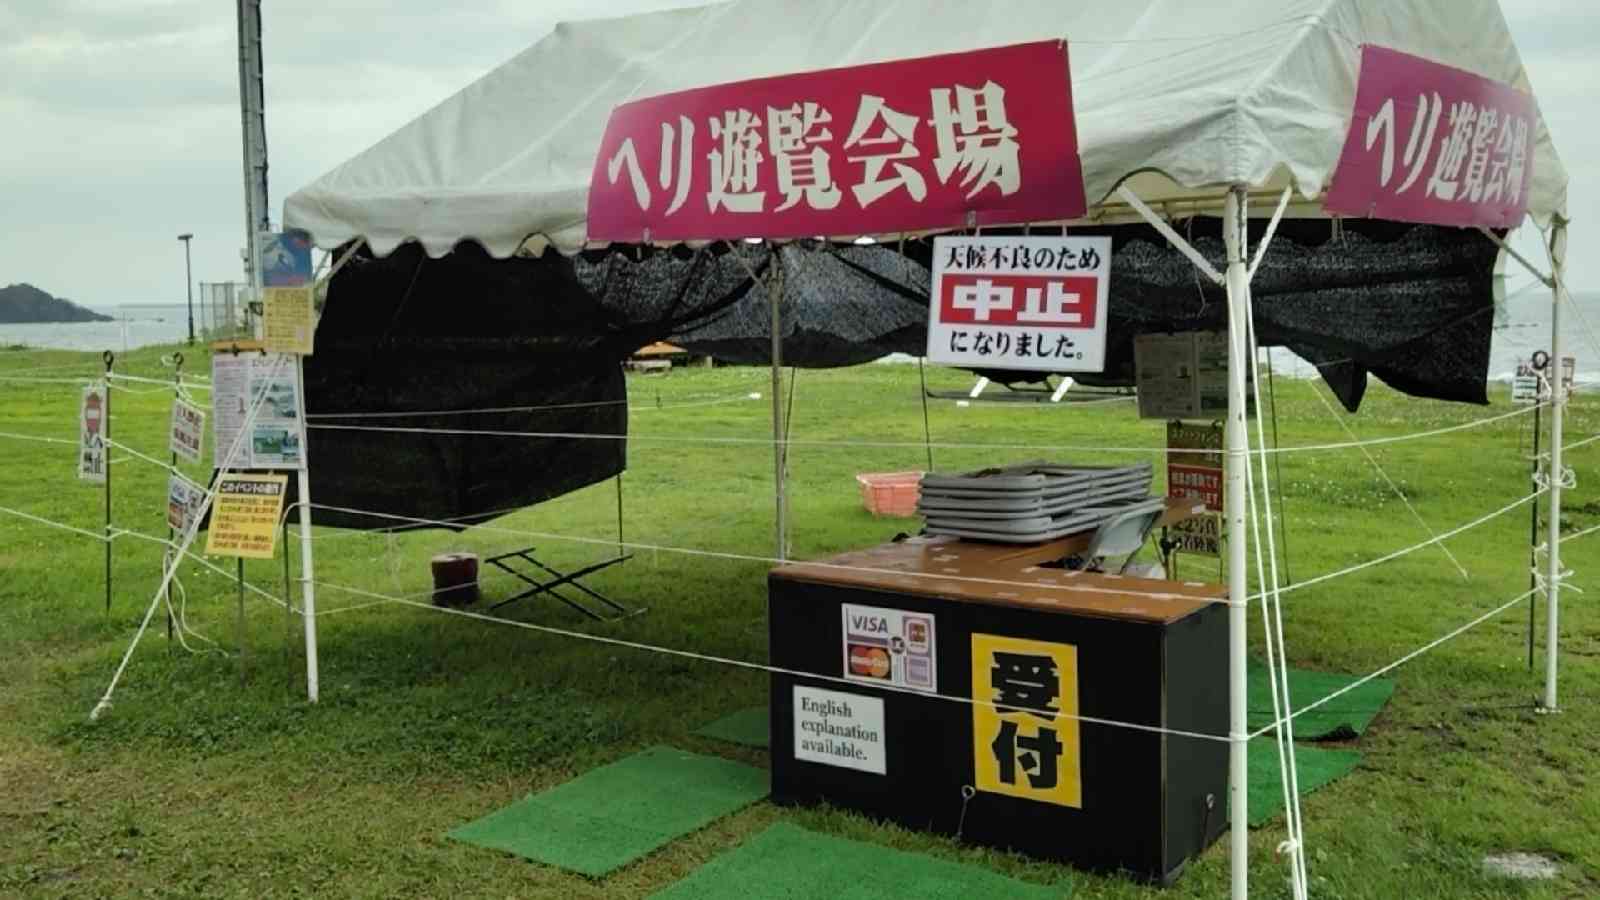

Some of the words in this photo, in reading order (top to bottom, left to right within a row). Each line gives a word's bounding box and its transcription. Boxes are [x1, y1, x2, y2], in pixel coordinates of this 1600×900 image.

[608, 80, 1022, 217] ヘリ遊覧会場
[944, 244, 1100, 270] 天候不良のため
[952, 280, 1082, 323] 中止
[950, 330, 1084, 360] になりました。
[852, 615, 888, 633] VISA
[801, 697, 852, 718] English
[992, 651, 1064, 790] 受付
[801, 719, 879, 742] explanation
[801, 739, 868, 761] available.
